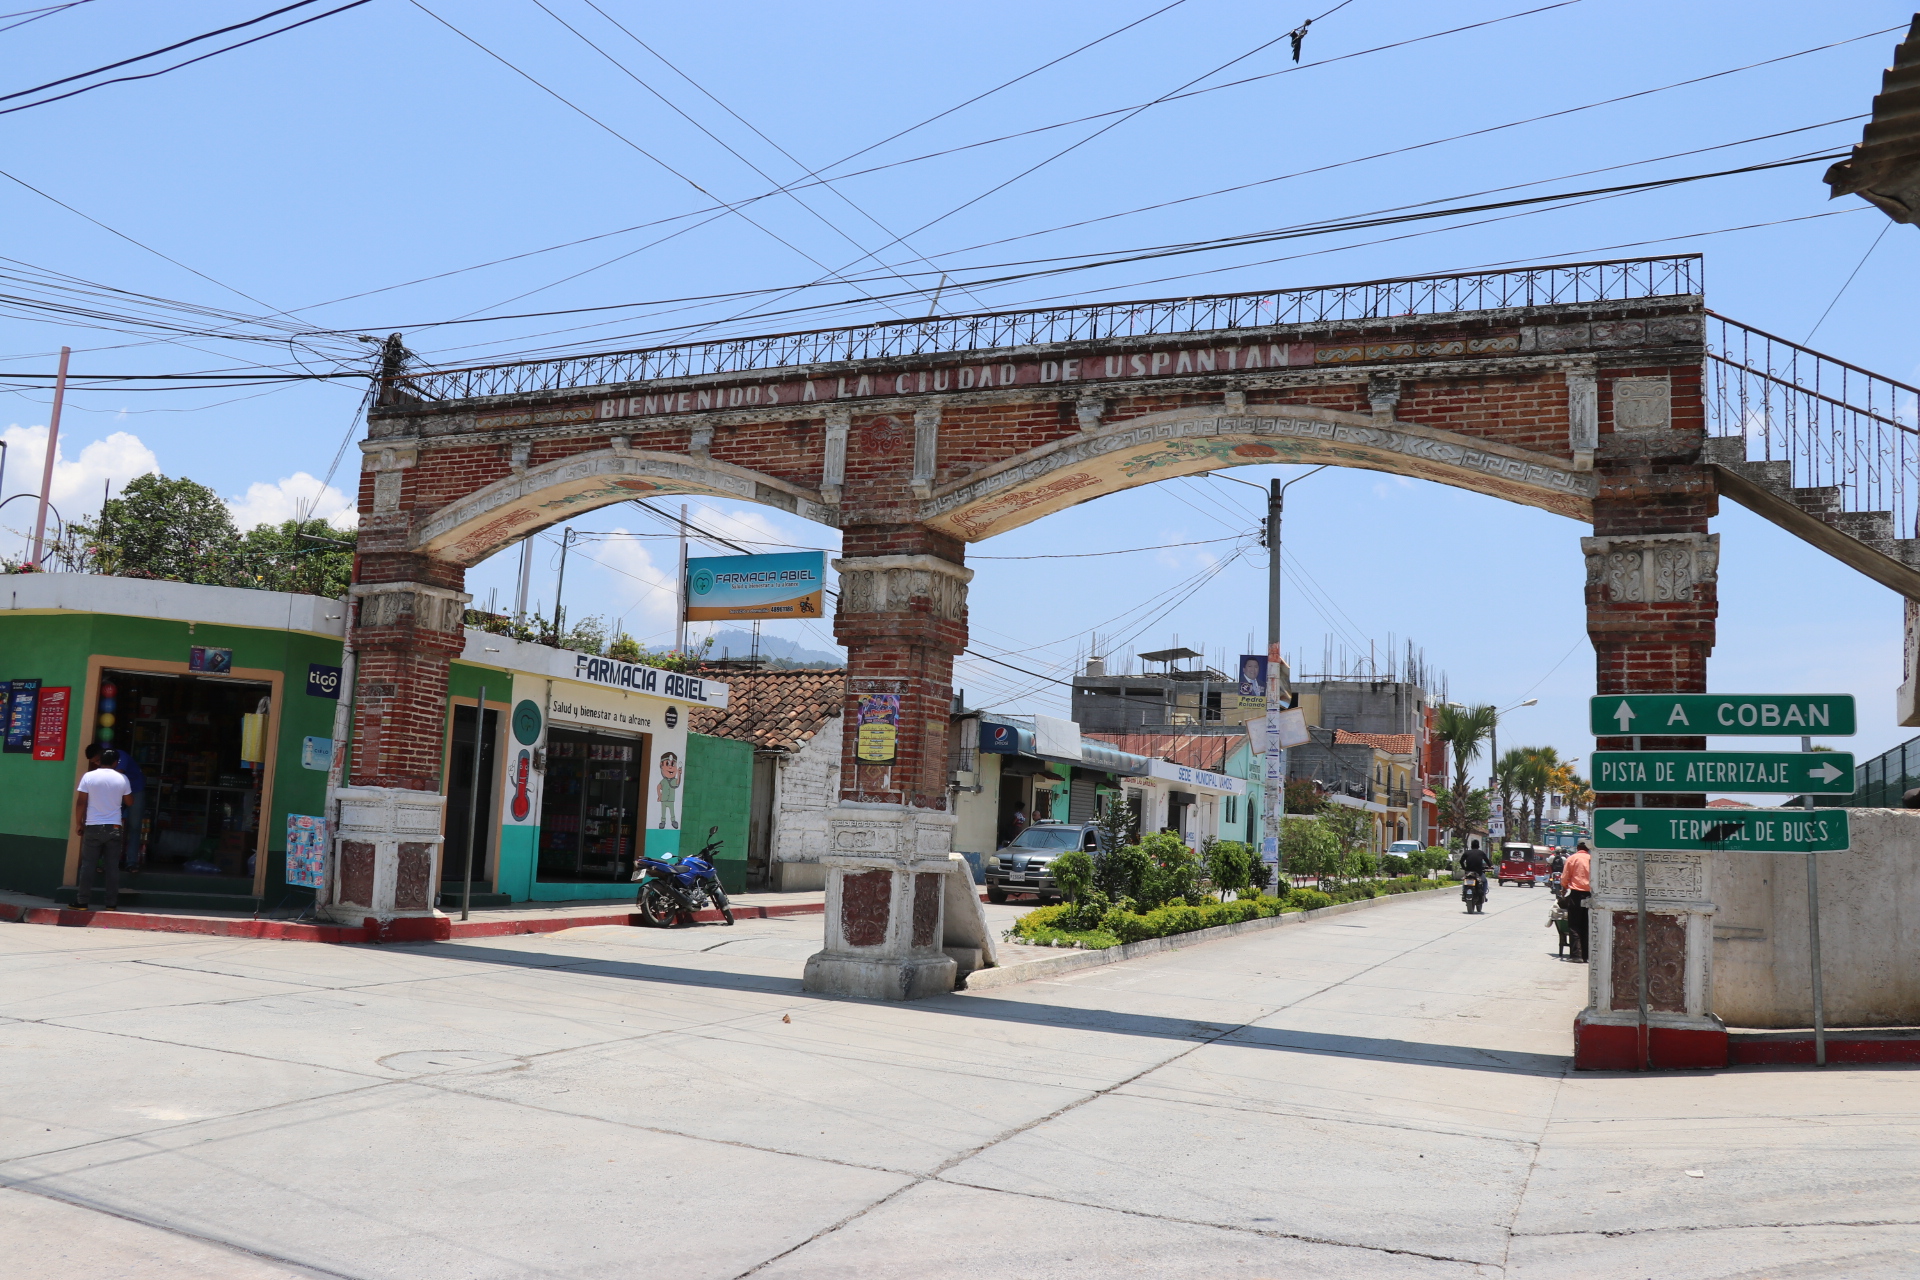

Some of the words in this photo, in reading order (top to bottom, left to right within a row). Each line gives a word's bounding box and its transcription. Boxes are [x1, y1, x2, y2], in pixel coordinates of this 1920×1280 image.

[600, 383, 780, 419] BIENVENIDOS
[803, 380, 816, 402] A
[837, 374, 871, 399] LA
[895, 363, 1017, 395] CIUDAD
[1040, 359, 1082, 384] DE
[1105, 343, 1290, 378] USPANTAN
[715, 571, 777, 583] FARMACIA
[780, 570, 815, 580] ABIEL
[575, 654, 657, 692] FARMACIA
[664, 674, 708, 702] ABIEL
[553, 700, 572, 714] Salud
[573, 706, 579, 719] y
[580, 705, 611, 720] bienestar
[613, 713, 618, 721] a
[619, 711, 627, 722] tu
[628, 714, 651, 727] alcance
[1667, 703, 1690, 726] A
[1717, 702, 1829, 727] COBAN
[1178, 767, 1191, 782] SEDE
[1195, 771, 1217, 787] MUNICIPAL
[1602, 762, 1647, 782] PISTA
[1655, 763, 1675, 782] DE
[1686, 763, 1789, 783] ATERRIZAJE
[1755, 821, 1775, 842] DE
